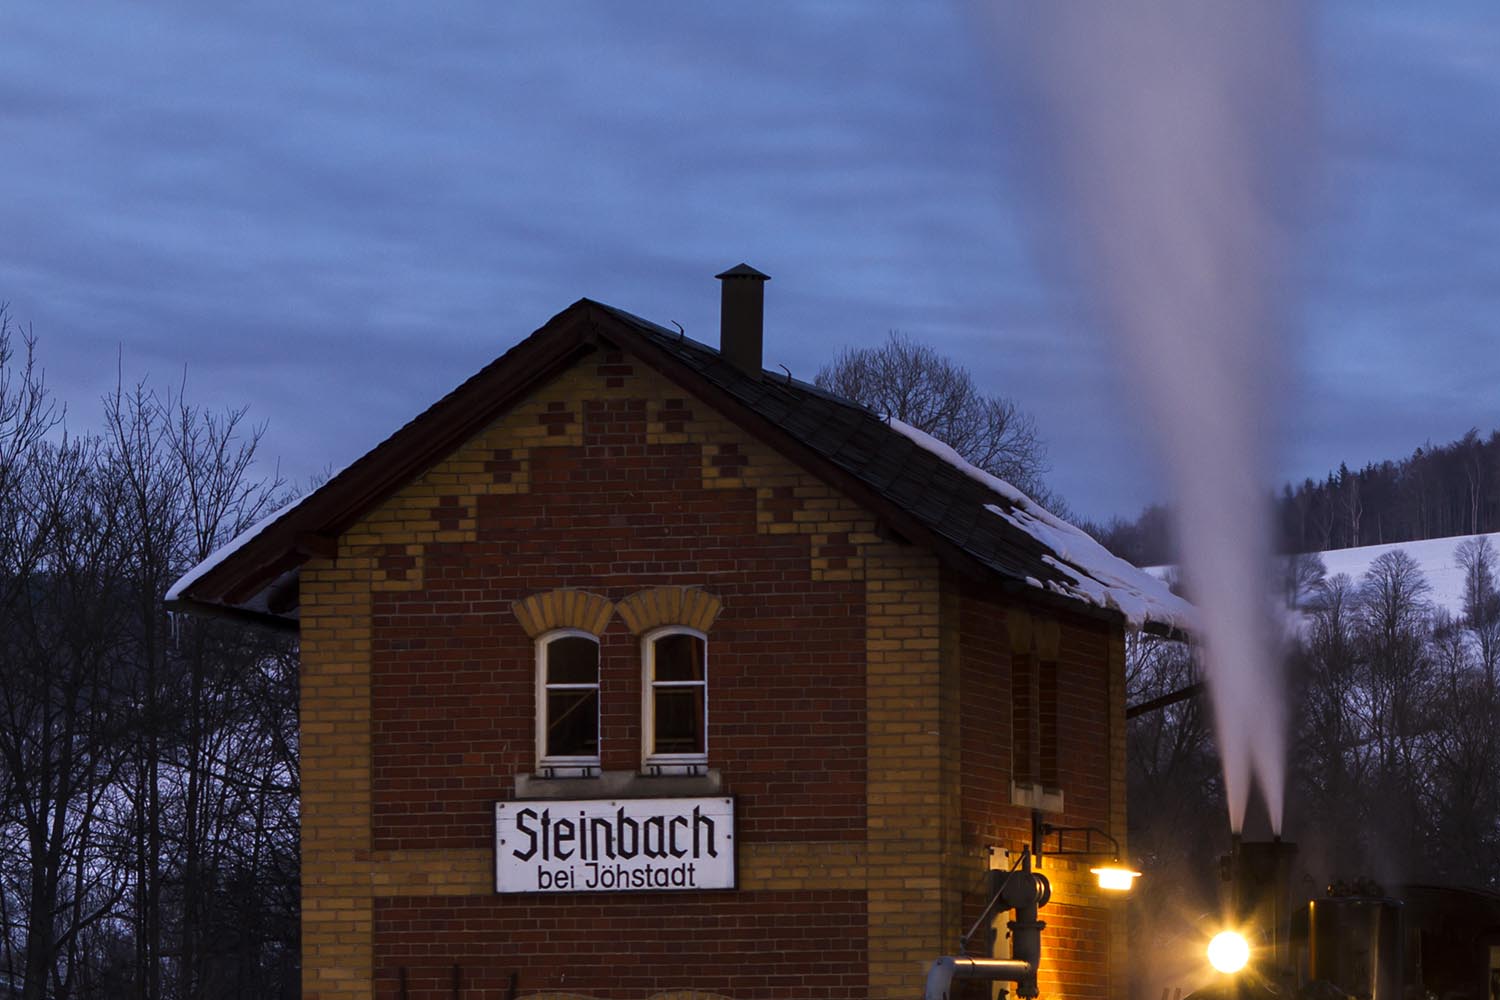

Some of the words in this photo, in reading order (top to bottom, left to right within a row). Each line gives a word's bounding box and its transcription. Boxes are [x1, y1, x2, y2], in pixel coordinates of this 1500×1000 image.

[512, 804, 718, 862] Steinbach
[538, 865, 575, 889] bei
[585, 862, 696, 888] Jöhstadt
